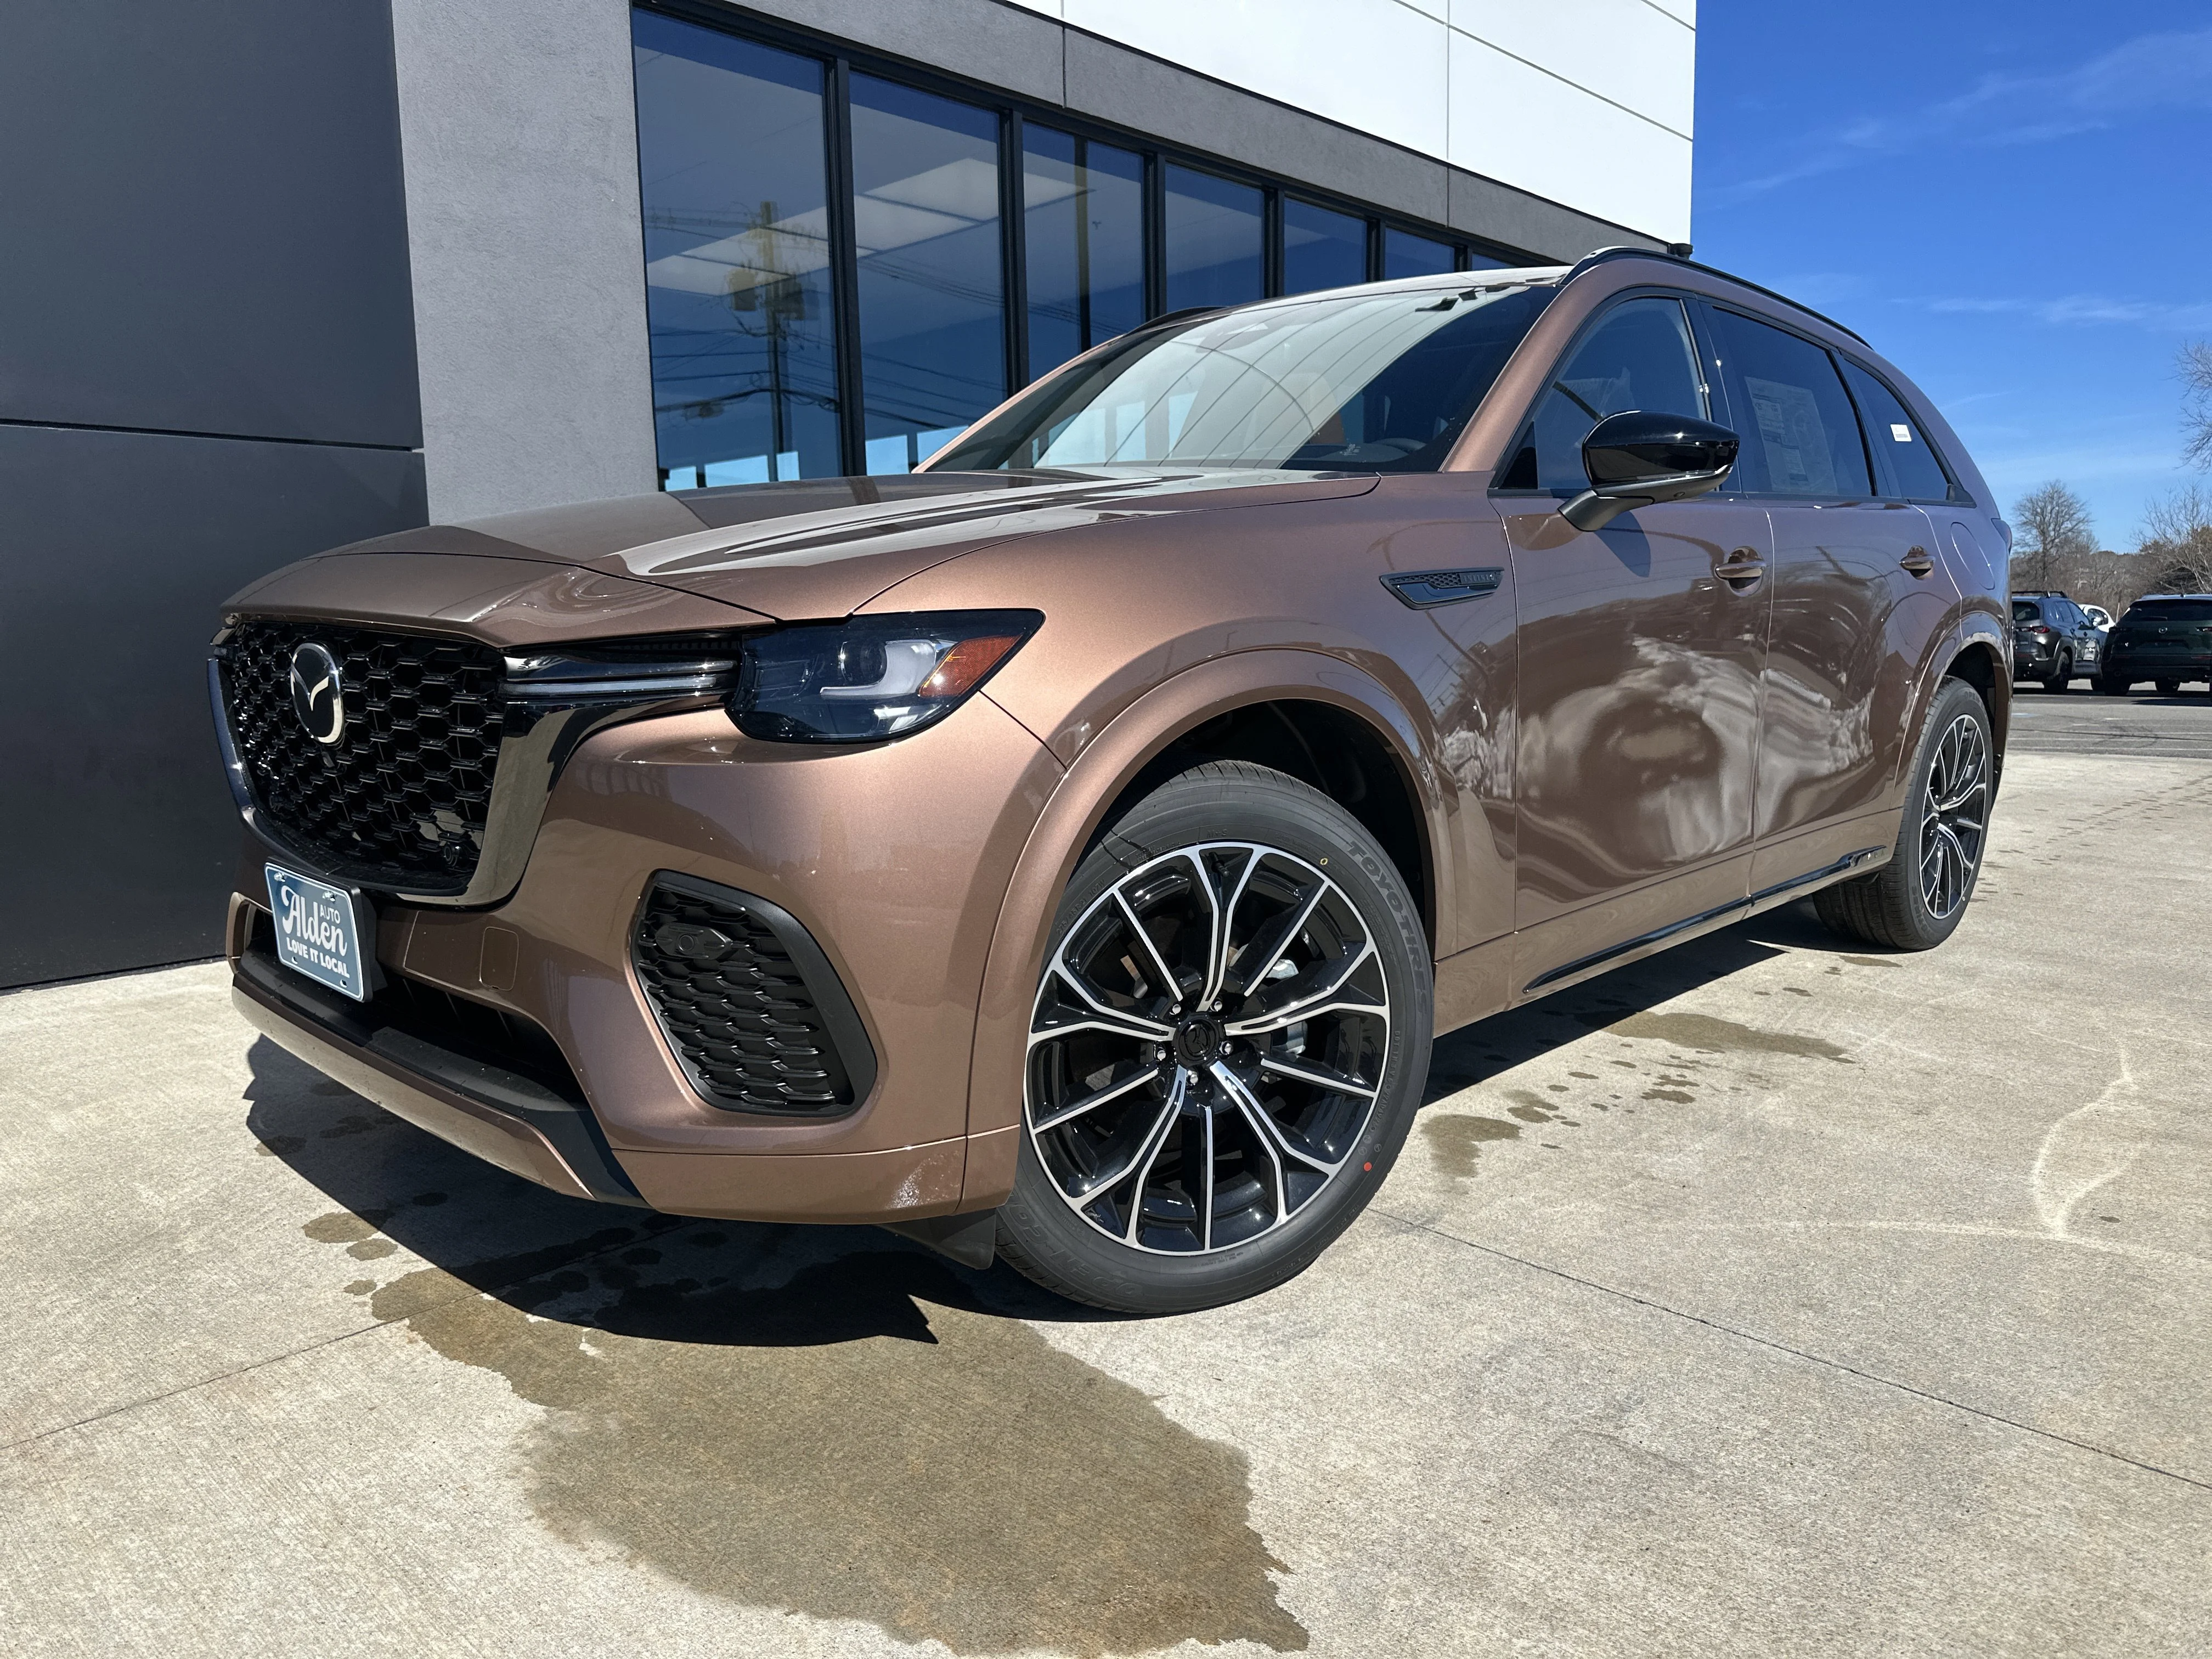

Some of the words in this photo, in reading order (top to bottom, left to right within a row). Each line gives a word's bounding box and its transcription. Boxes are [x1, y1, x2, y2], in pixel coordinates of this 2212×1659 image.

[281, 885, 347, 957] Alden
[320, 904, 341, 924] AUTO
[1347, 840, 1404, 913] TOYO
[1399, 915, 1427, 1013] TIRES
[286, 937, 309, 960] LOVE
[309, 947, 319, 964] IT
[319, 952, 351, 979] LOCAL
